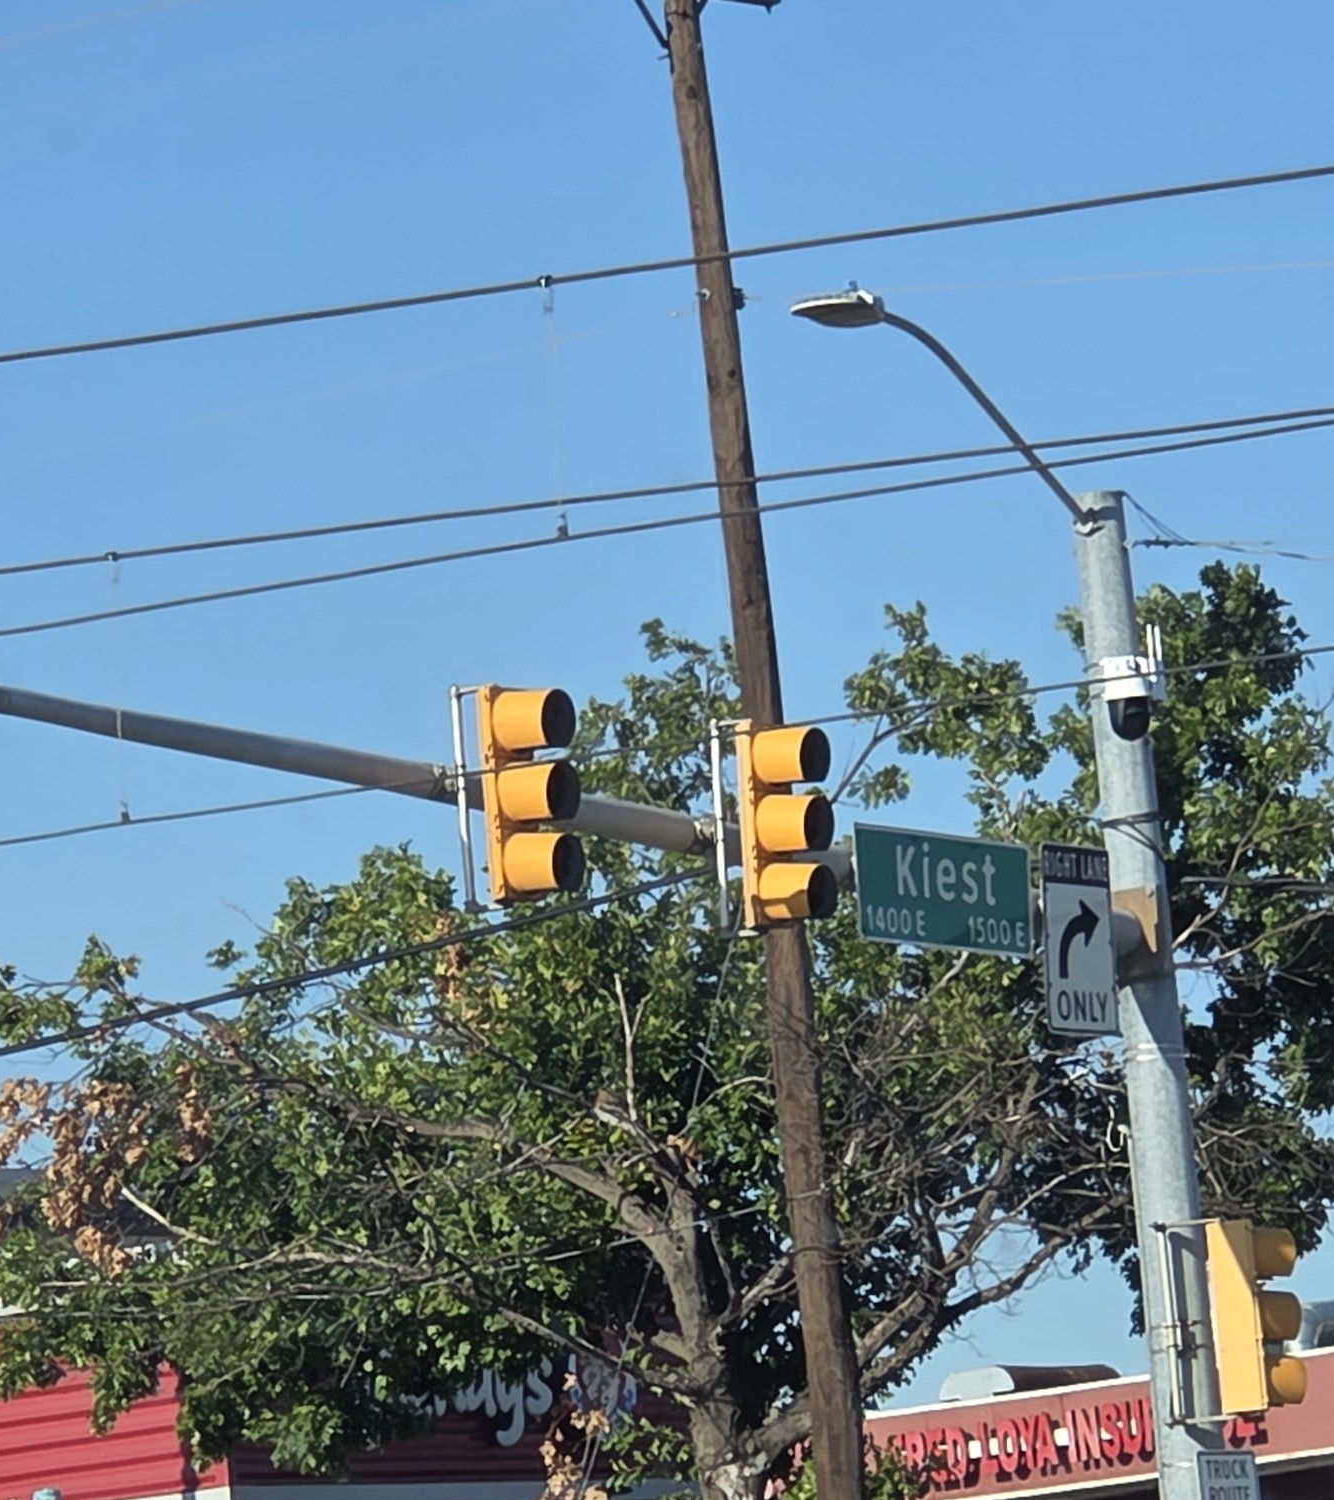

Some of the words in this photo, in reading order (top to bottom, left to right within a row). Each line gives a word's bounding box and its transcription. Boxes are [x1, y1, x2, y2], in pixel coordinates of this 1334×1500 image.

[896, 841, 996, 906] Kiest
[1044, 850, 1077, 878] RIGHT
[1080, 854, 1108, 882] LANE
[866, 904, 912, 935] 1400
[916, 910, 927, 937] E
[968, 916, 1012, 946] 1500
[1015, 921, 1026, 948] E
[1057, 989, 1109, 1024] ONLY
[978, 1411, 1059, 1475] LOYA
[1205, 1459, 1249, 1481] TRUCK
